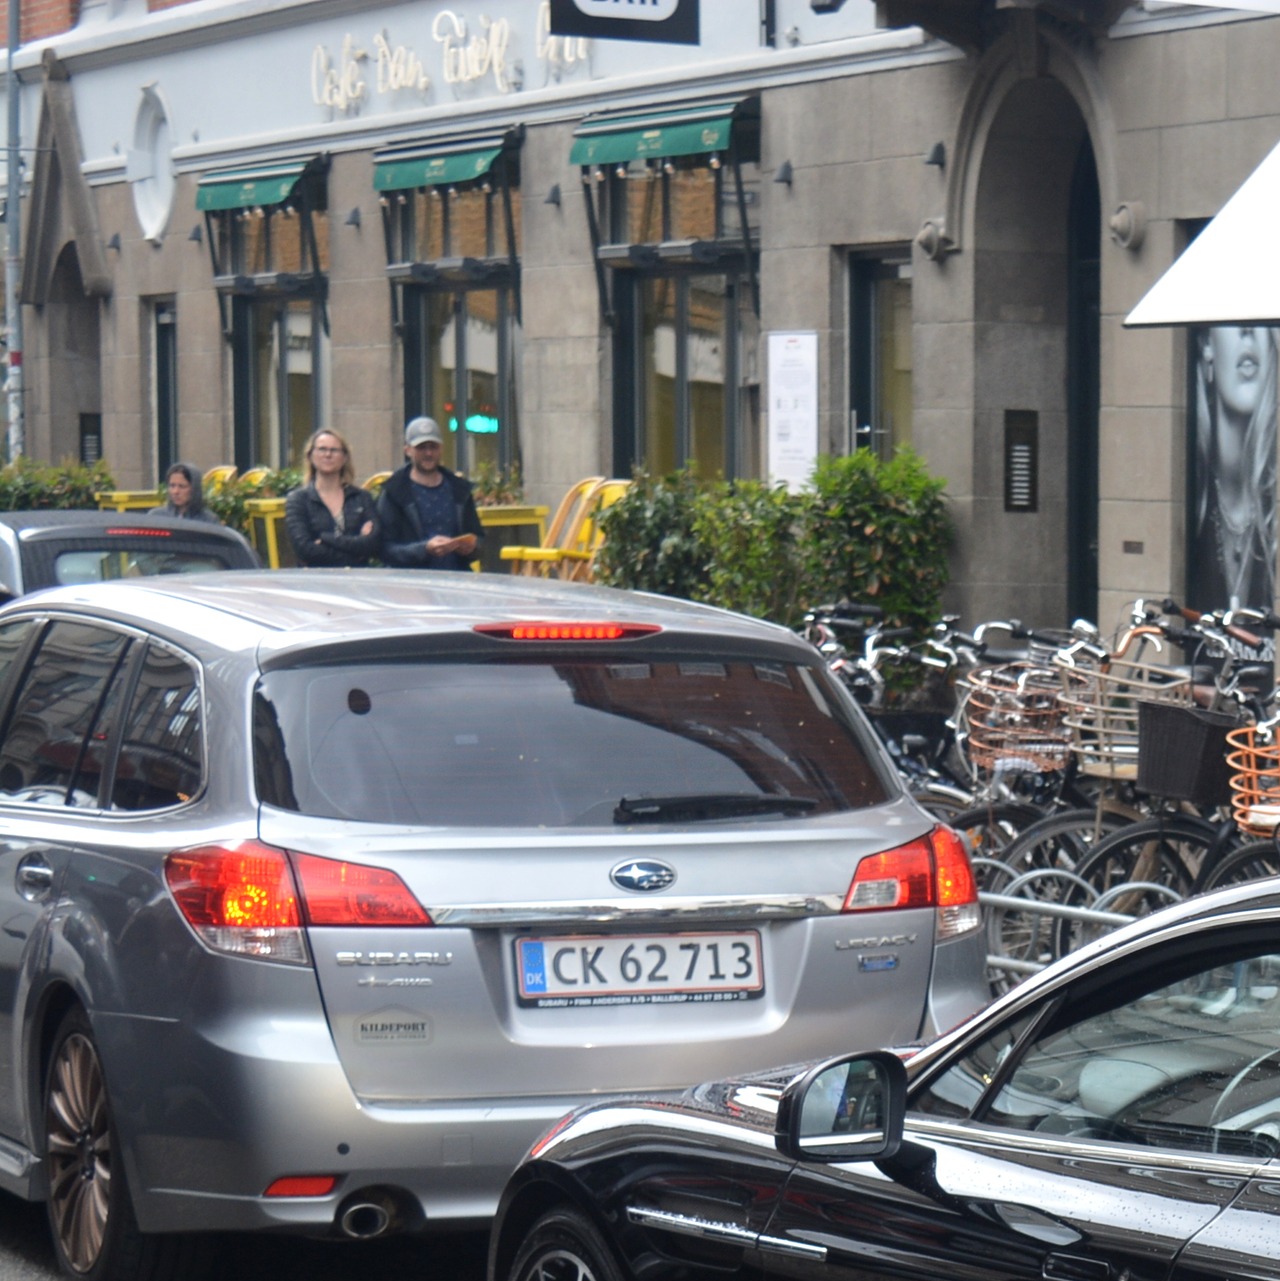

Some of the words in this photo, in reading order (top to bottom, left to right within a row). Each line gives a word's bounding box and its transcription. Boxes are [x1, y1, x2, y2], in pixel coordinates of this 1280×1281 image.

[834, 933, 919, 951] LEGACY
[336, 951, 453, 967] SUBARU
[552, 945, 609, 986] CK
[619, 943, 669, 984] 62
[679, 941, 754, 982] 713
[526, 971, 544, 986] DK
[360, 1022, 428, 1033] KILDEPORT
